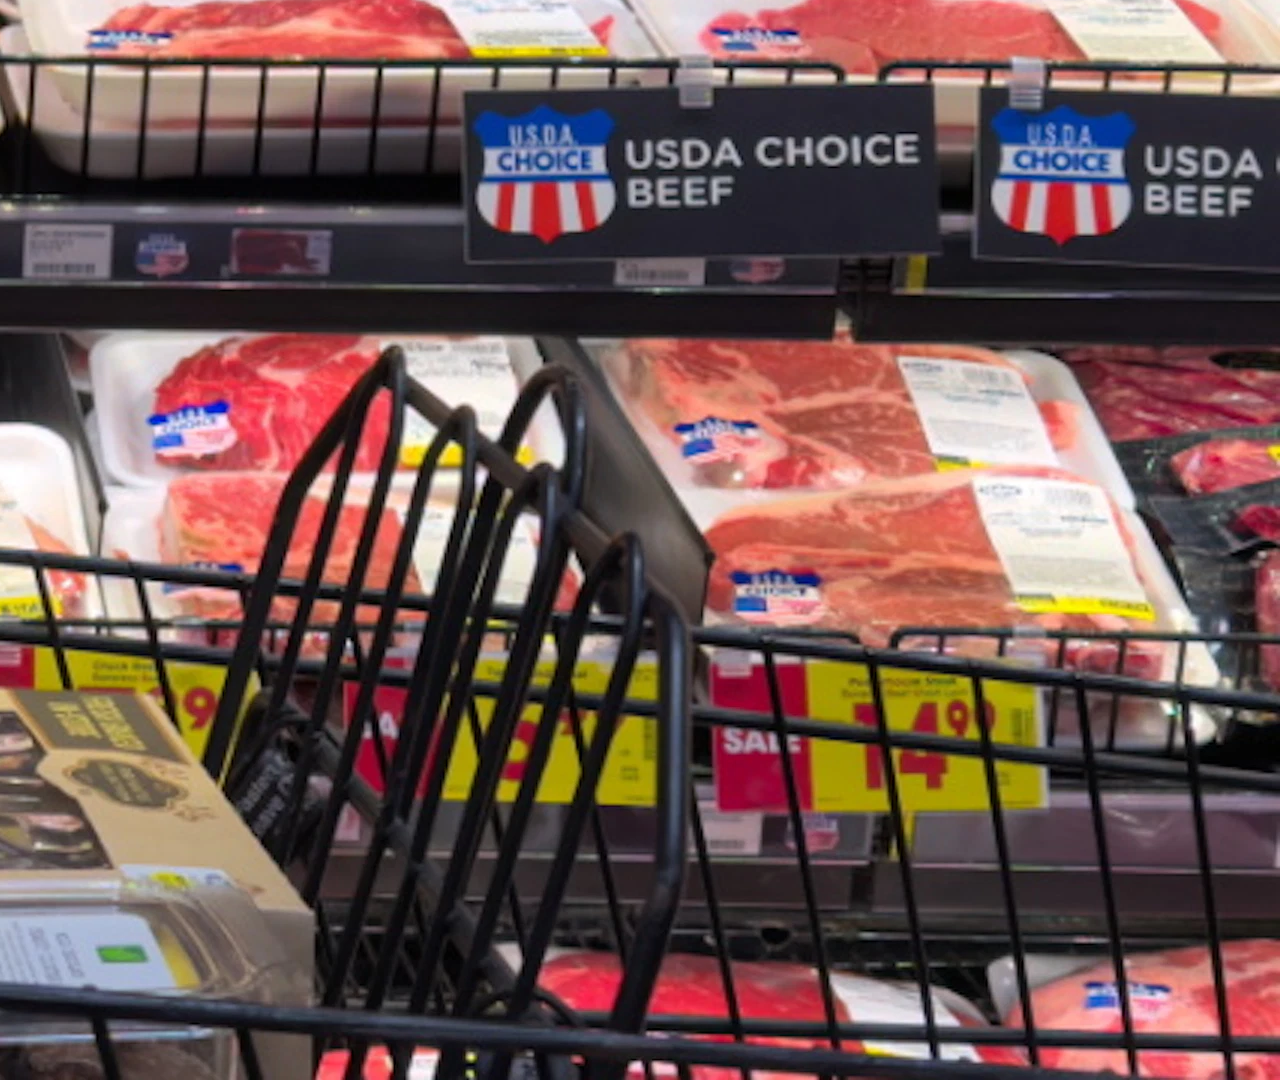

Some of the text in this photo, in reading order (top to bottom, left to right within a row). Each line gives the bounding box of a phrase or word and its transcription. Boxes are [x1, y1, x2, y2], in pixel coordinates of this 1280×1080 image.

[507, 123, 579, 146] U.S.D.A.
[1025, 122, 1098, 148] U.S.D.A.
[497, 150, 593, 172] CHOICE
[624, 133, 920, 170] USDA CHOICE
[1013, 149, 1111, 173] CHOICE
[1144, 145, 1263, 179] USDA
[626, 176, 733, 208] BEEF
[1144, 184, 1253, 217] BEEF
